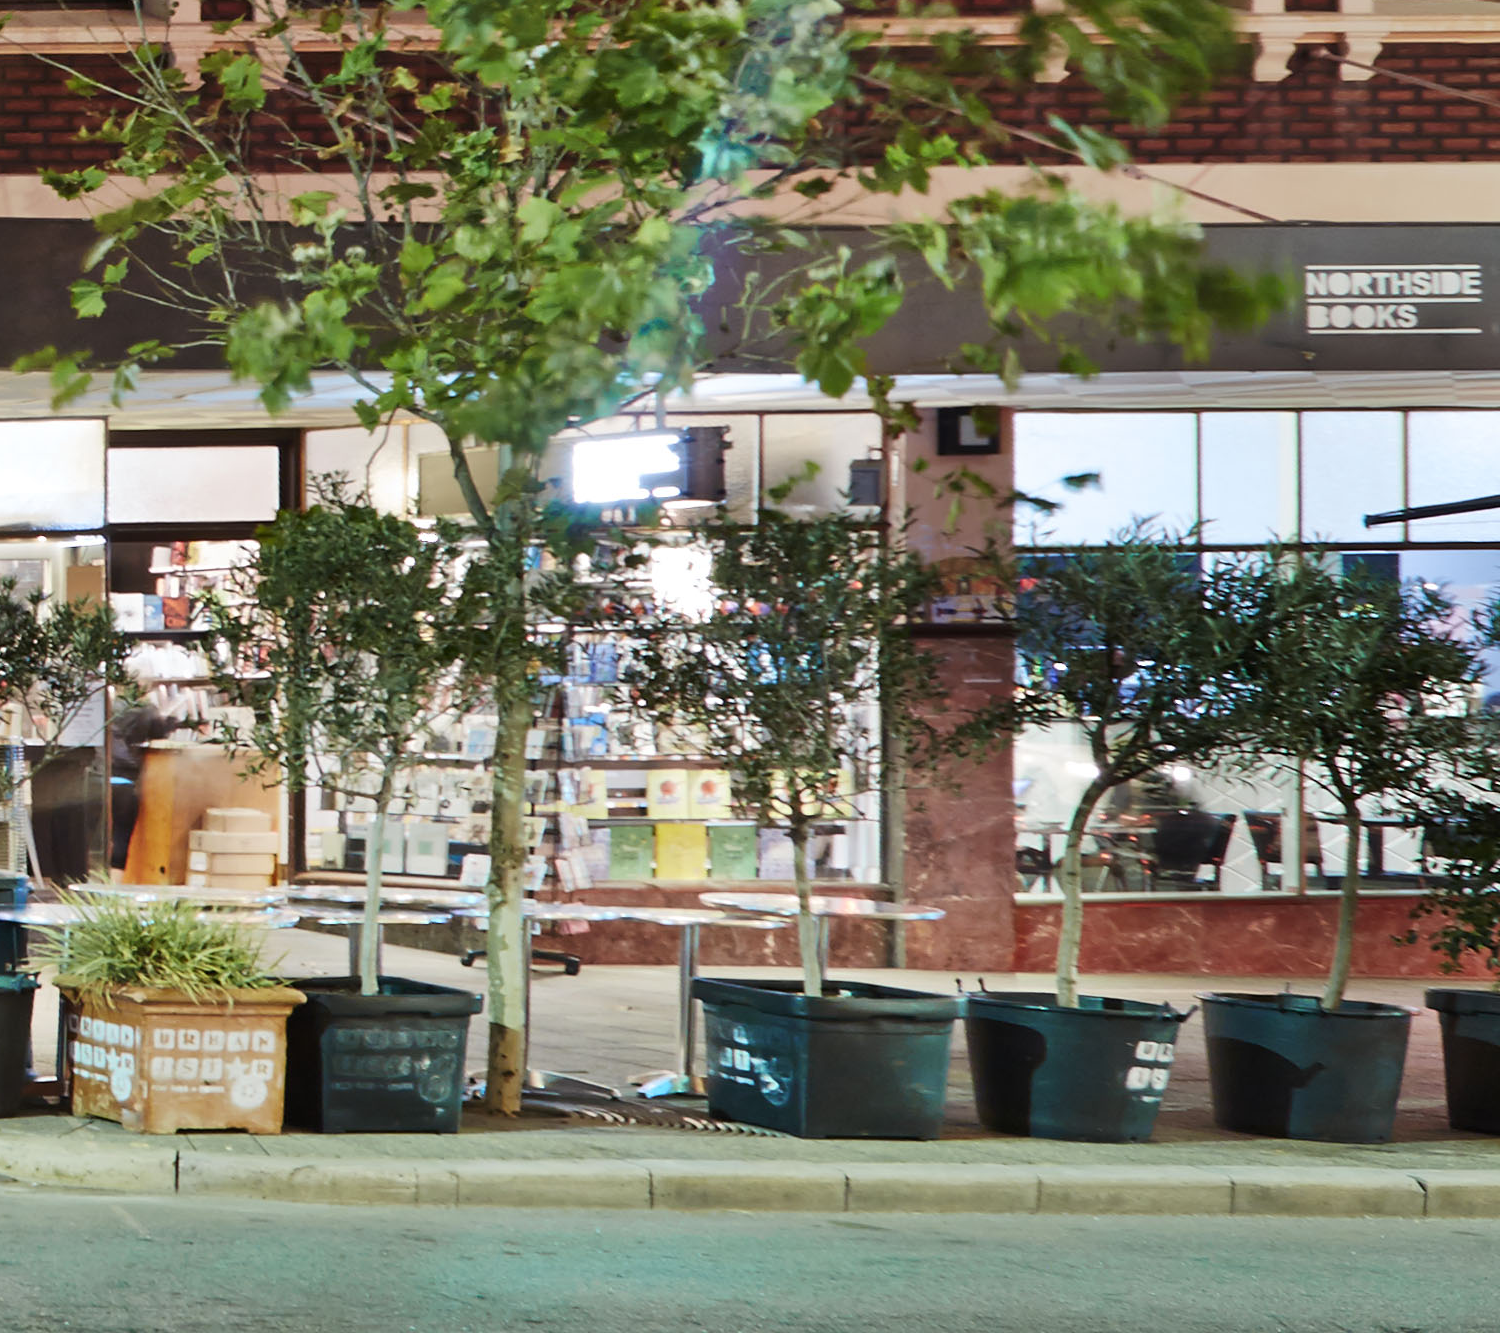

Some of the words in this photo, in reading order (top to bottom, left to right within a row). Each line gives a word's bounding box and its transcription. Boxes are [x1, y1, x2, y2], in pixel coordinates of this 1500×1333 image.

[1304, 271, 1483, 296] NORTHSIDE
[1307, 304, 1418, 329] BOOKS
[153, 1028, 276, 1053] URBAN
